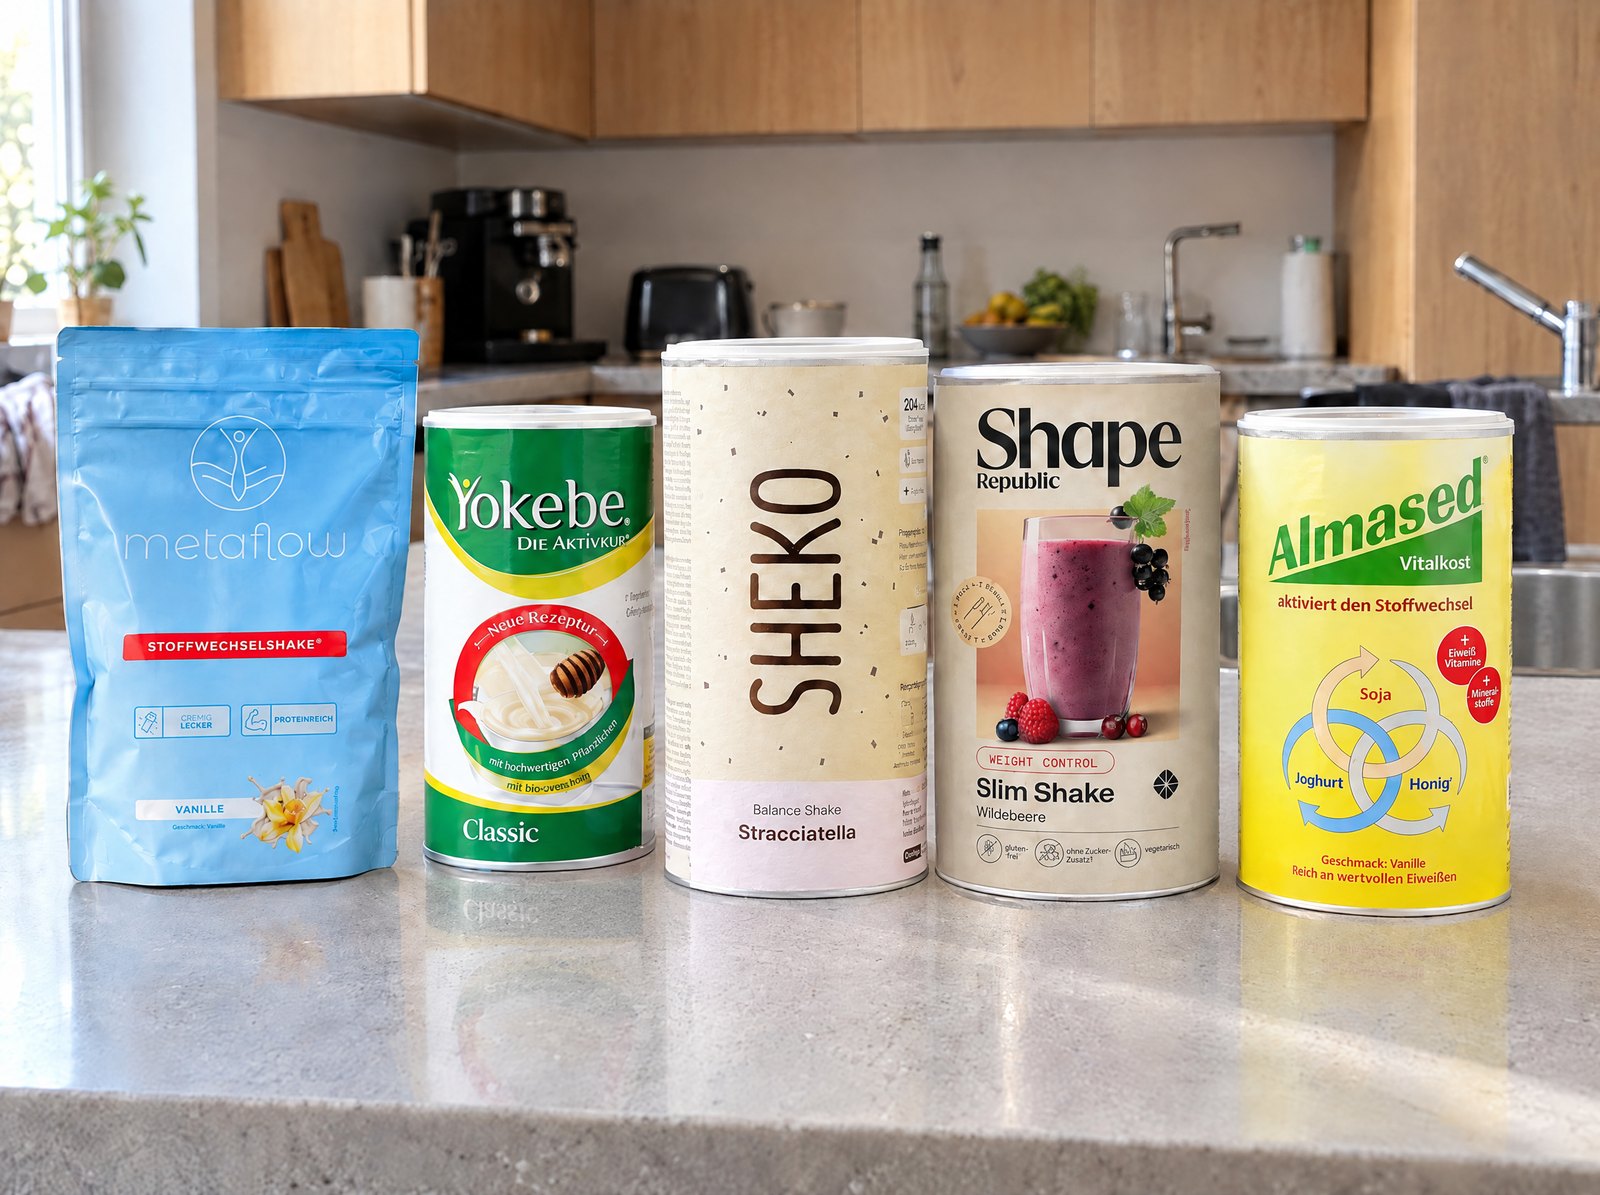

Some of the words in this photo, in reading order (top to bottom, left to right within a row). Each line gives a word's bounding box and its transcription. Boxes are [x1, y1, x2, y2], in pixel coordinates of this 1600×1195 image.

[904, 398, 918, 411] 204
[977, 407, 1182, 487] Shape
[976, 472, 1061, 493] Republic
[124, 522, 346, 561] metaflow
[1399, 555, 1471, 571] Vitalkost
[749, 468, 842, 715] SHEKO
[1278, 594, 1337, 611] aktiviert
[1340, 597, 1371, 612] den
[1375, 596, 1473, 613] Stoffwechsel
[487, 616, 525, 637] Neue
[528, 611, 598, 636] Rezeptur
[1448, 646, 1476, 658] Eiweiß
[1444, 657, 1482, 668] Vitamine
[1360, 687, 1392, 704] Soja
[1474, 698, 1495, 708] stoffe
[180, 714, 212, 722] CREMIG
[180, 721, 213, 730] LECKER
[273, 714, 334, 724] PROTEINREICH
[489, 757, 504, 768] mit
[504, 757, 571, 773] hochwertigen
[571, 719, 618, 762] Pflanzlichen
[989, 754, 1033, 767] WEIGHT
[1042, 757, 1098, 769] CONTROL
[506, 782, 523, 792] mit
[1295, 772, 1344, 789] Joghurt
[976, 777, 1028, 802] Slim
[1034, 781, 1115, 803] Shake
[175, 804, 225, 814] VANILLE
[753, 803, 801, 816] Balance
[804, 804, 842, 816] Shake
[976, 805, 1047, 823] Wildebeere
[462, 818, 540, 843] Classic
[738, 823, 856, 842] Stracciatella
[1004, 844, 1029, 854] gluten-
[1066, 847, 1084, 855] ohne
[1085, 846, 1112, 855] Zucker-
[1144, 842, 1181, 853] vegetarisch
[1321, 855, 1388, 869] Geschmack:
[1390, 858, 1426, 869] Vanille
[1292, 865, 1318, 879] Reich
[1320, 871, 1334, 881] an
[1337, 872, 1404, 884] wertvollen
[1407, 871, 1457, 884] Eiweißen
